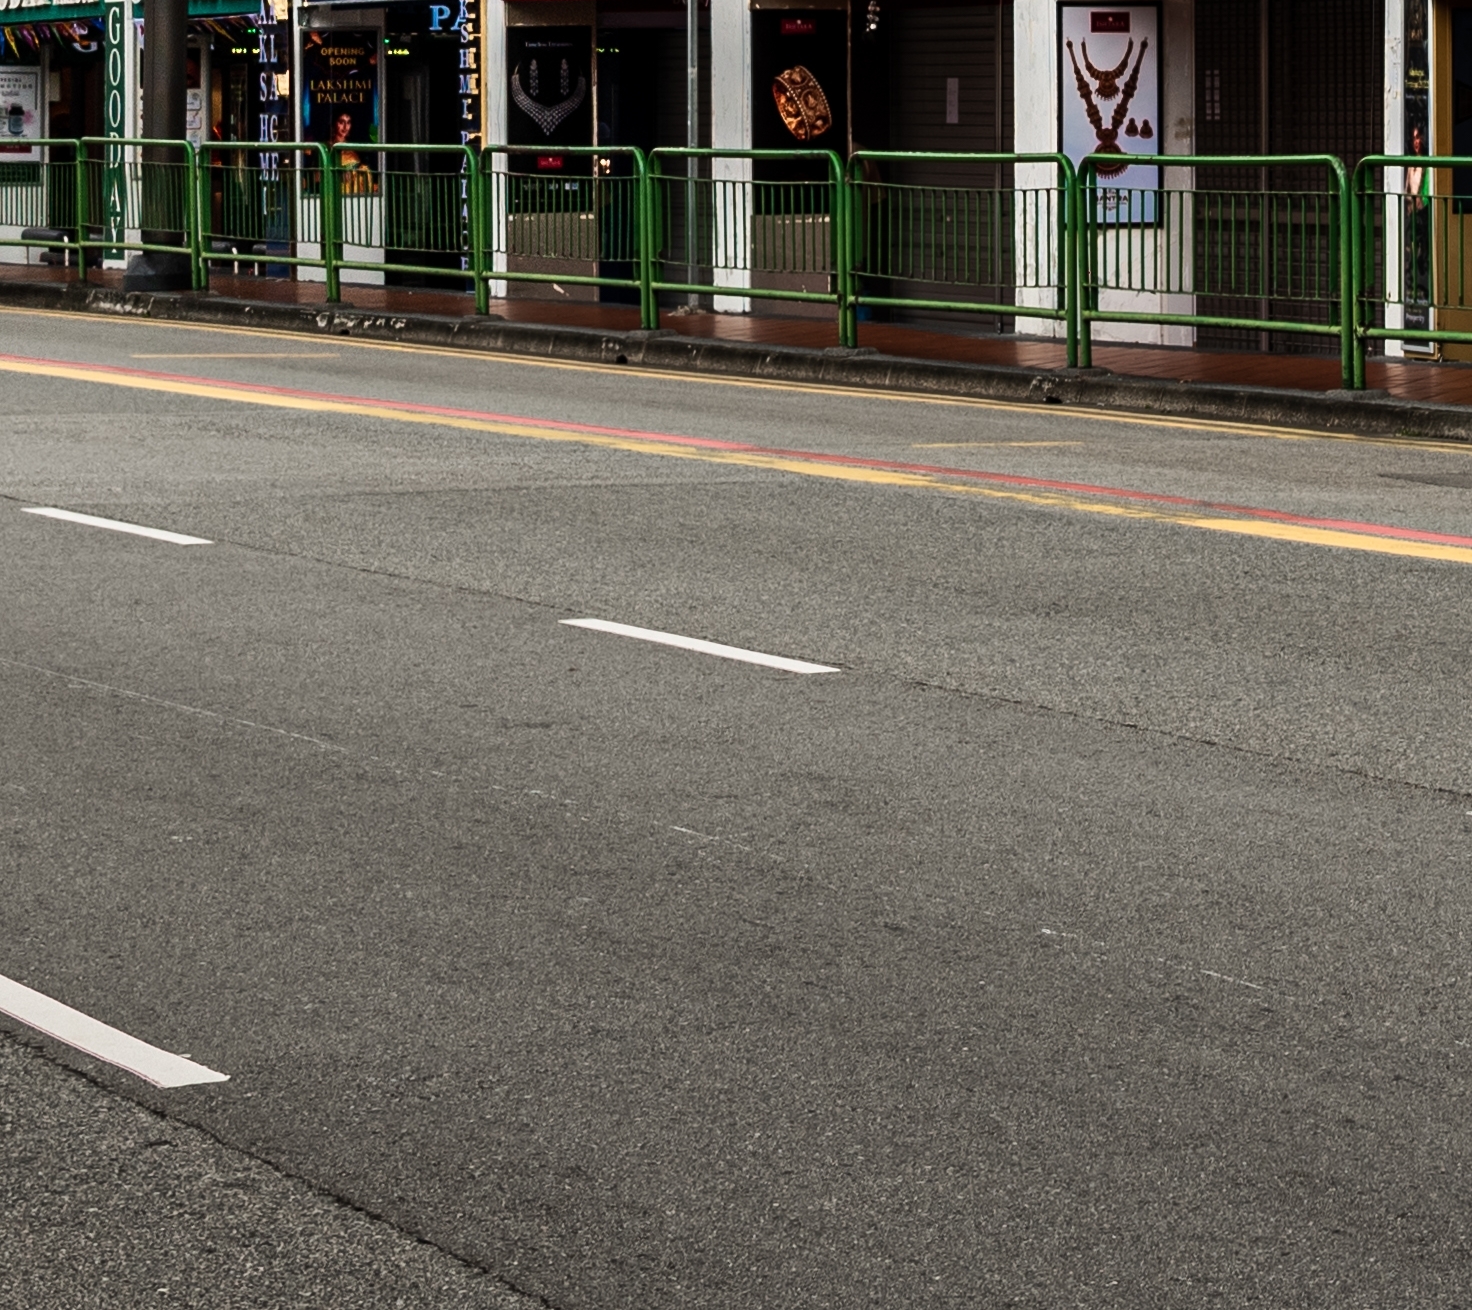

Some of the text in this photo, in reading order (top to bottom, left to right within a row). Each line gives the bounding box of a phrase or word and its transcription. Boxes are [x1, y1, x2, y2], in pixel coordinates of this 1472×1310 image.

[320, 47, 365, 56] OPENING
[329, 57, 357, 66] SOON
[310, 79, 372, 91] LAKSHMI
[316, 92, 367, 104] PALACE
[108, 6, 122, 254] GOODAY
